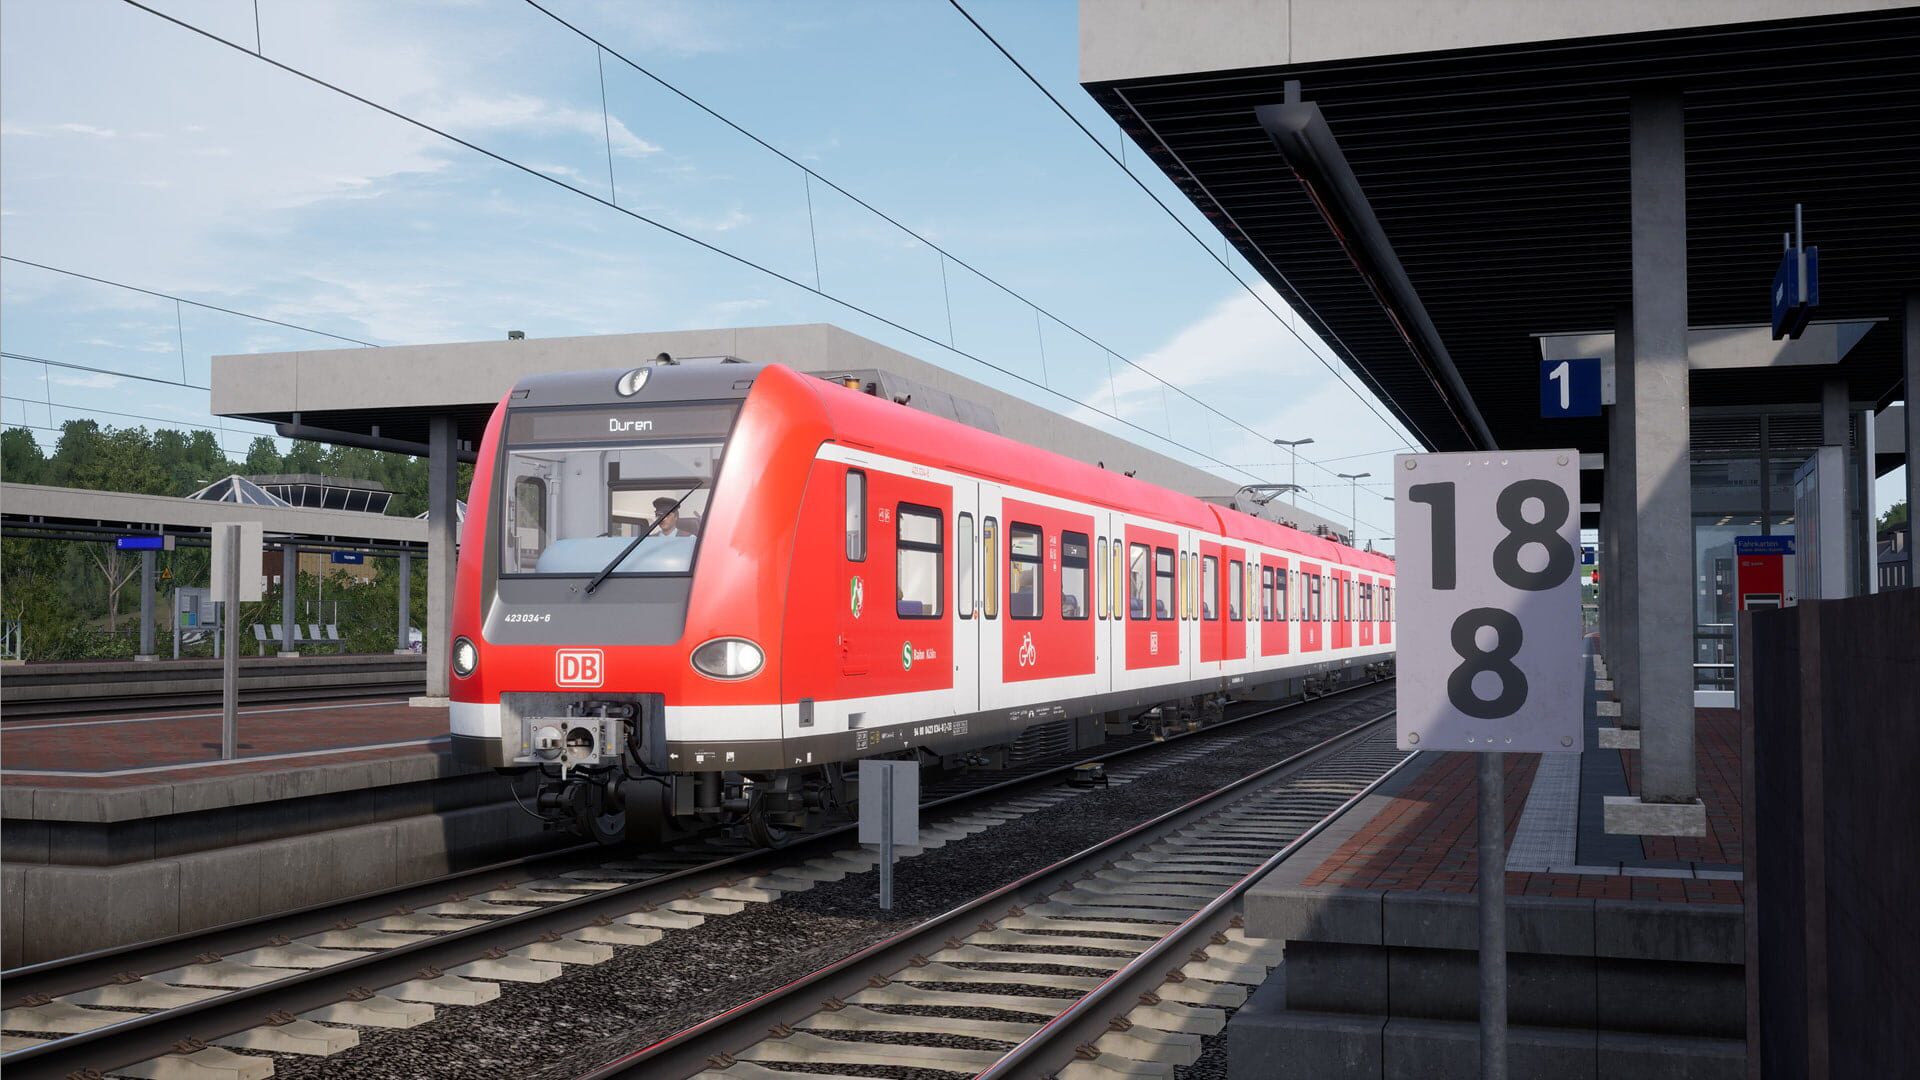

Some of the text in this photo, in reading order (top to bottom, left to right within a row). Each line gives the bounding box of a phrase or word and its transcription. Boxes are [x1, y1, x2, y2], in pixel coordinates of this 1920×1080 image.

[1549, 361, 1570, 410] 1
[609, 418, 653, 431] Duren
[1409, 479, 1575, 591] 18
[562, 655, 598, 680] DB
[1447, 607, 1529, 719] 8
